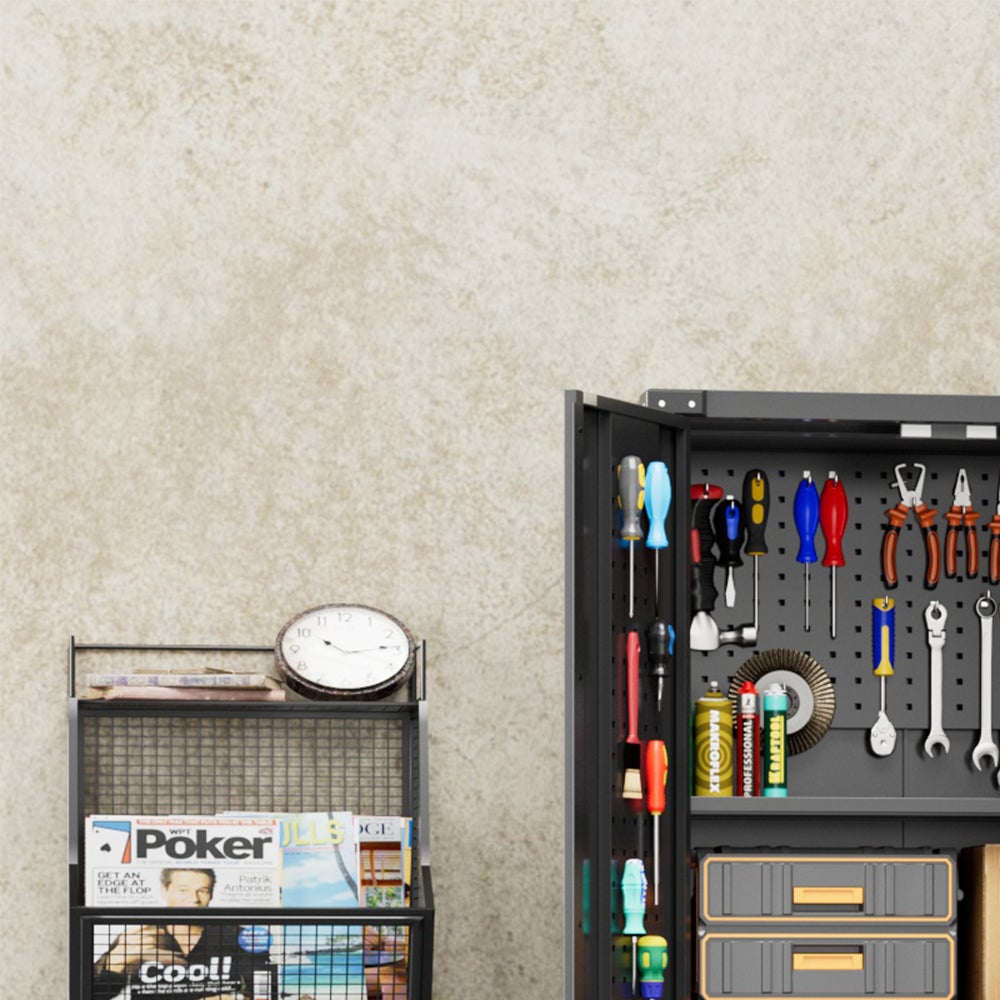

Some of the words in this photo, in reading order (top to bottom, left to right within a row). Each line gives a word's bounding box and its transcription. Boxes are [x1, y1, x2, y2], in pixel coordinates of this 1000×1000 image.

[317, 617, 327, 626] 11
[338, 612, 352, 623] 12
[297, 628, 311, 638] 10
[384, 629, 393, 638] 2
[289, 644, 300, 654] 9
[710, 710, 720, 792] MAKROFLEX
[743, 720, 753, 797] PROFESSIONAL
[136, 829, 272, 859] Poker
[239, 875, 271, 883] Patrik
[224, 884, 272, 892] Antonius
[140, 956, 232, 984] Cool!
